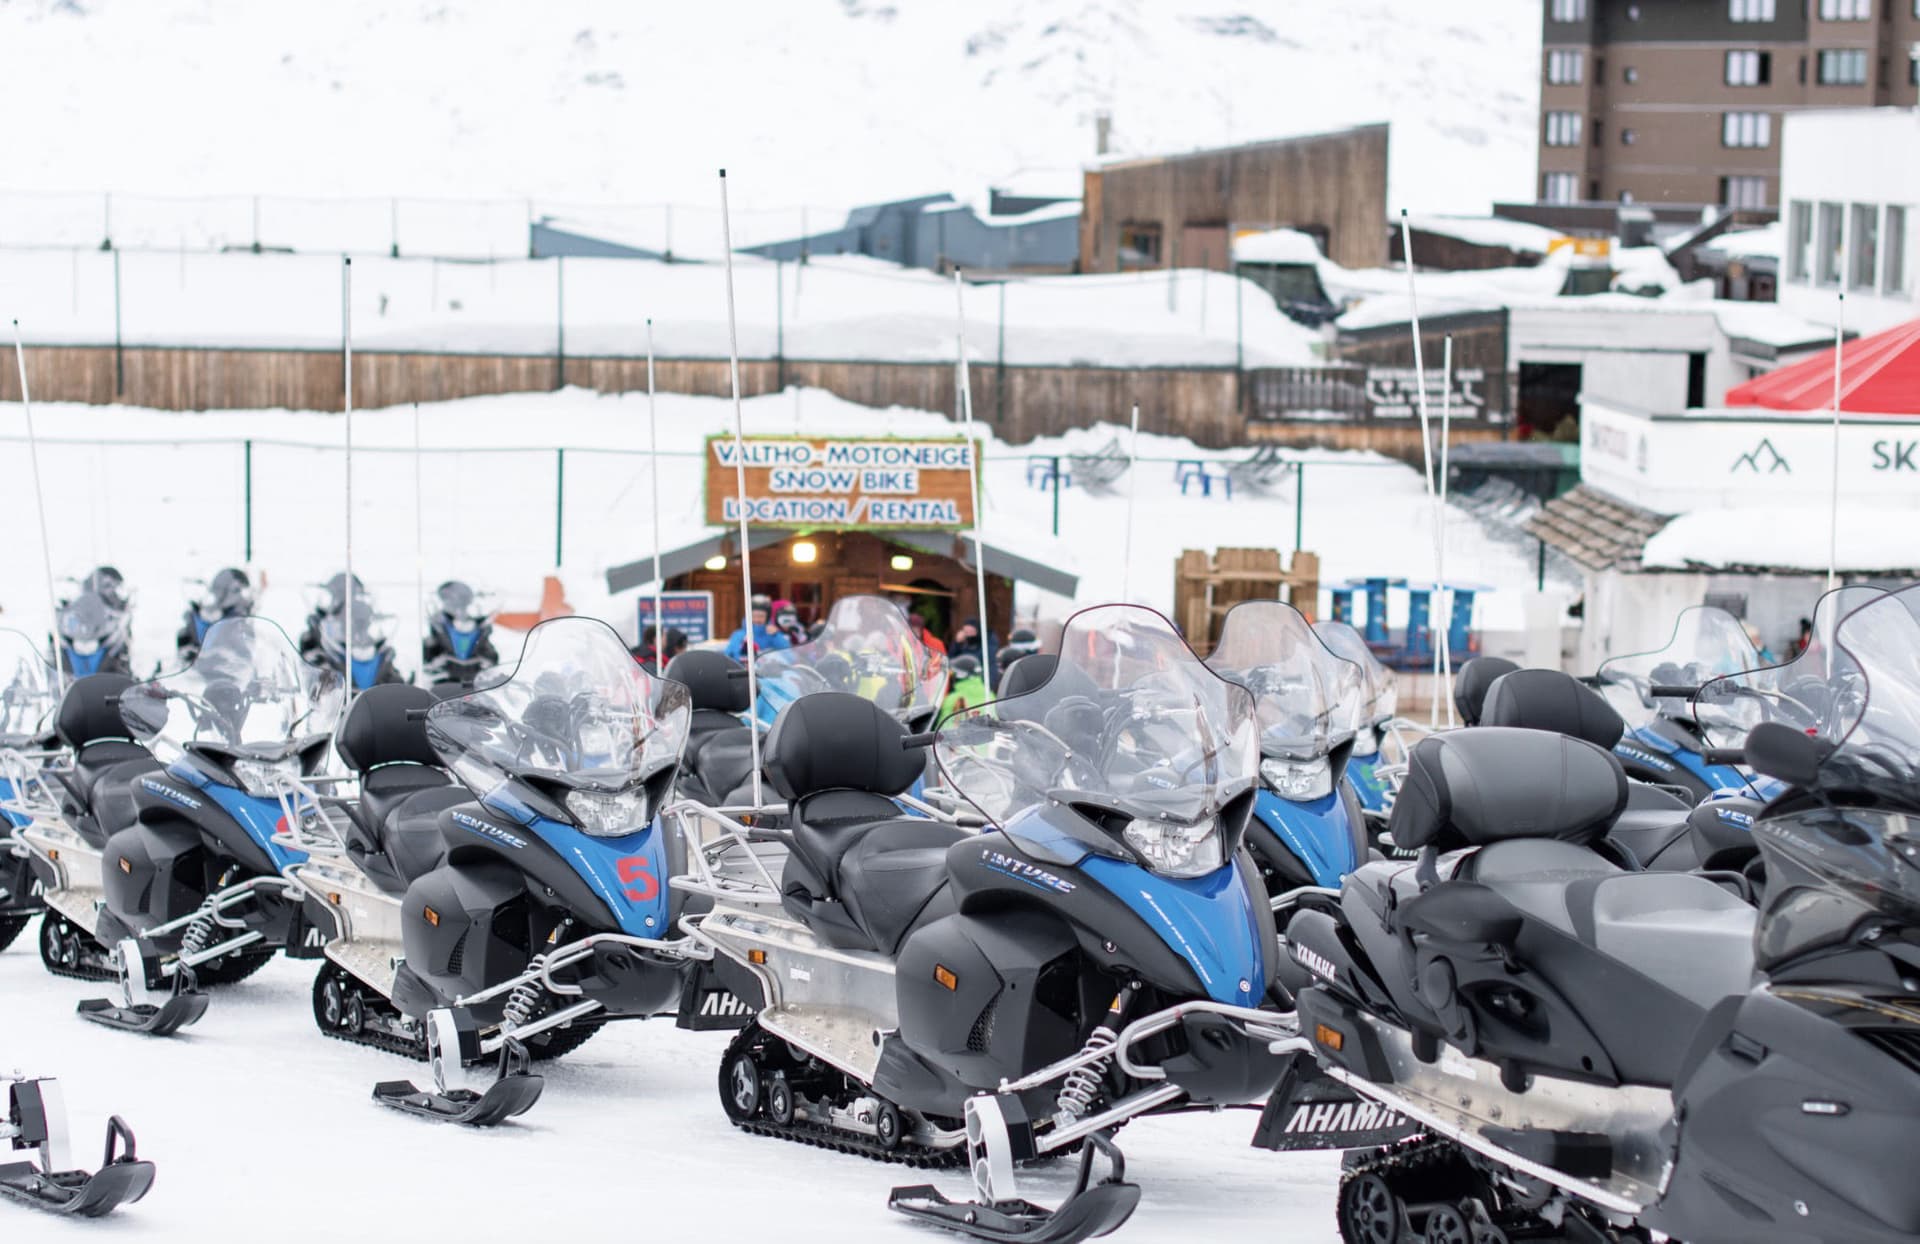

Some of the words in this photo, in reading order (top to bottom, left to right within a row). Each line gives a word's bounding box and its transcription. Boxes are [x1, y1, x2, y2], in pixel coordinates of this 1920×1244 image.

[717, 444, 811, 463] VALTHO
[827, 445, 971, 466] MOTONEIGE
[773, 470, 854, 489] SNOW
[863, 471, 915, 490] BIKE
[725, 500, 846, 519] LOCATION
[870, 502, 958, 521] RENTAL
[451, 810, 528, 849] VENTURE
[616, 856, 659, 902] 5
[1297, 942, 1336, 984] YAMAHA
